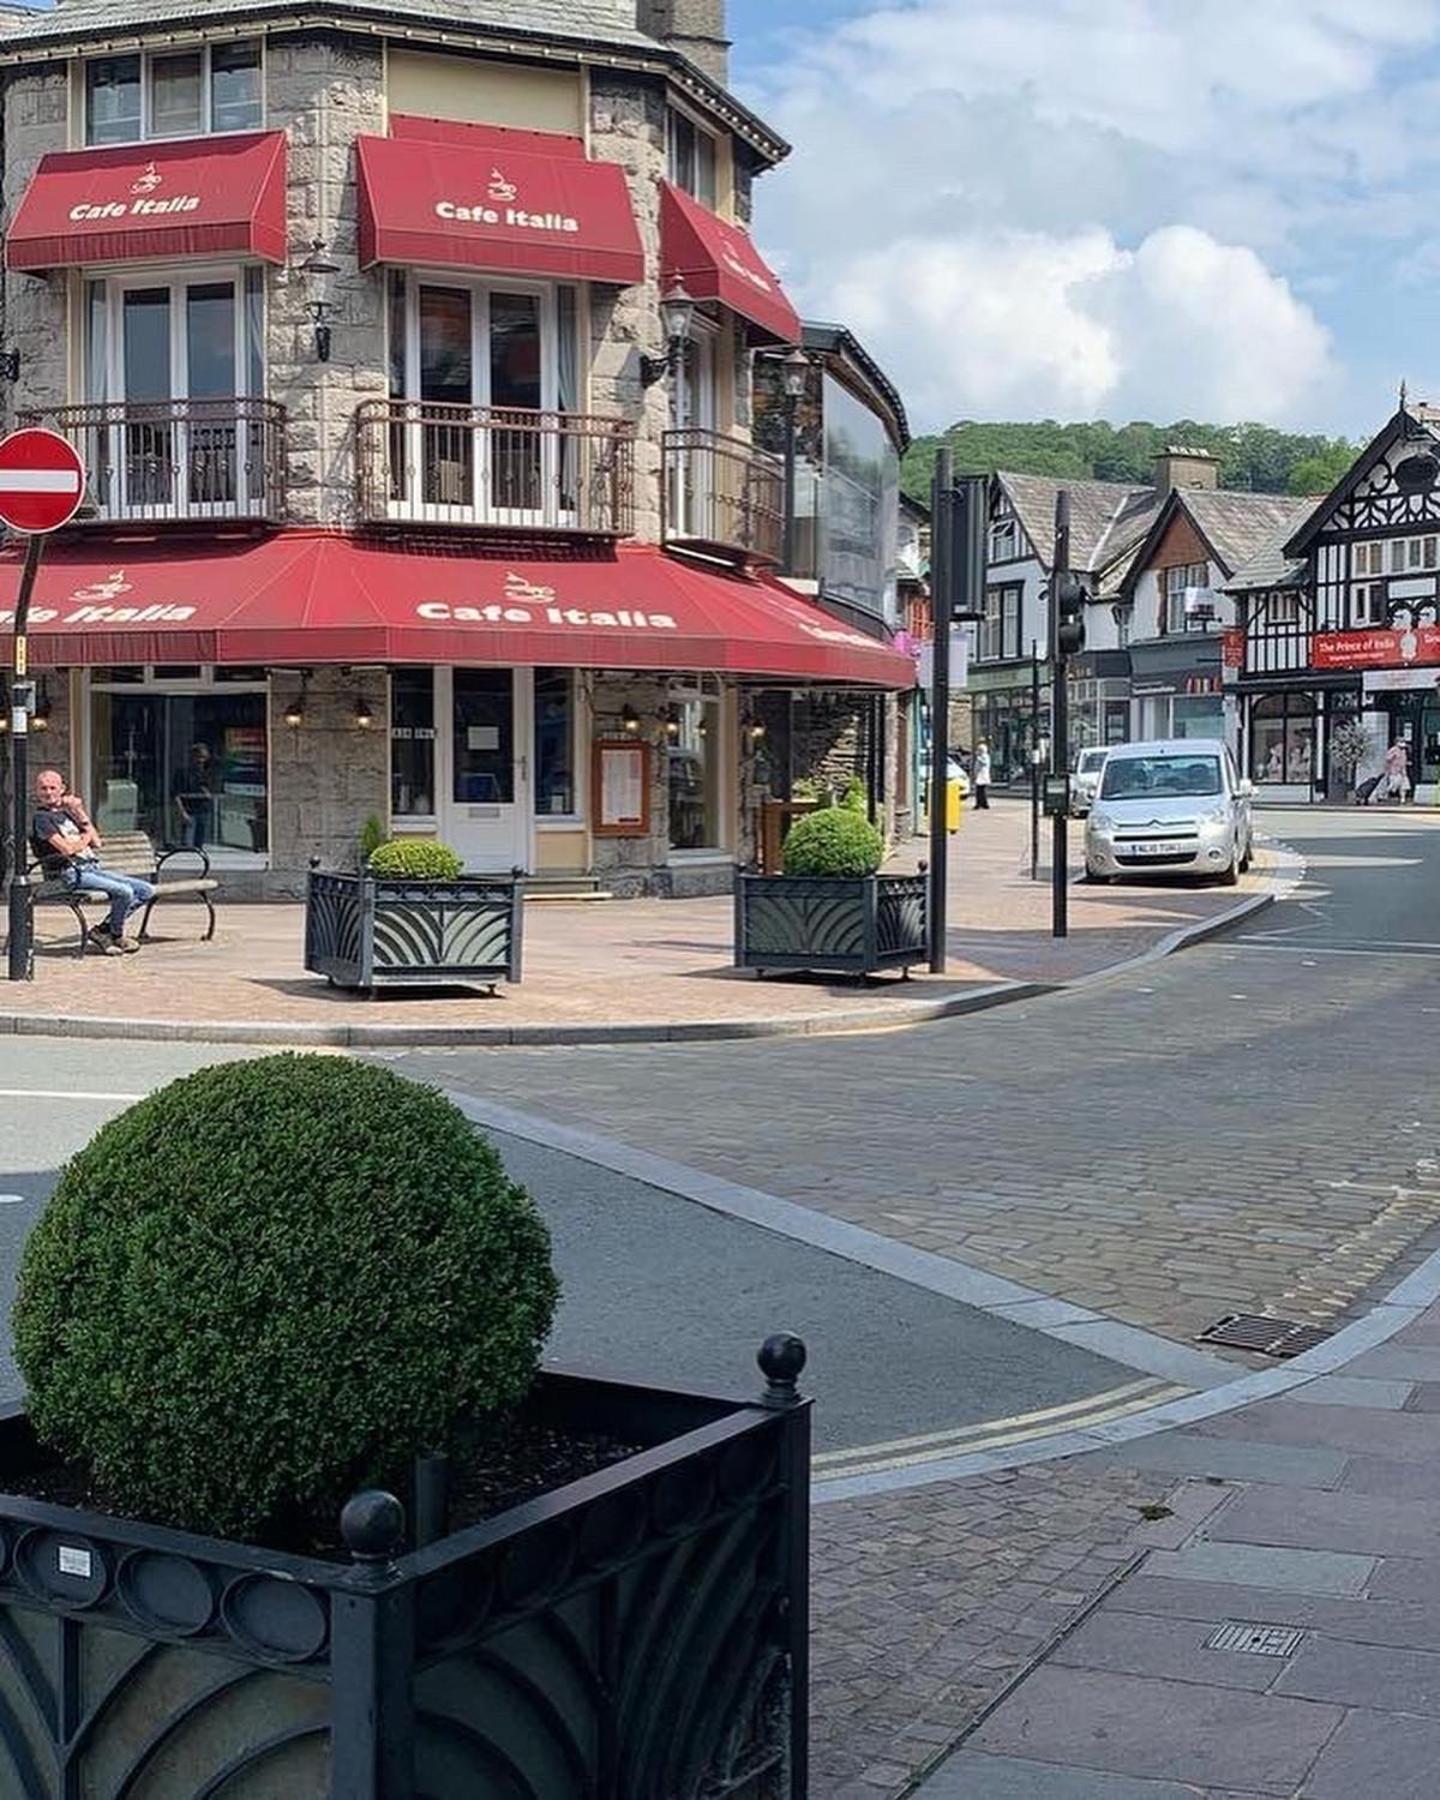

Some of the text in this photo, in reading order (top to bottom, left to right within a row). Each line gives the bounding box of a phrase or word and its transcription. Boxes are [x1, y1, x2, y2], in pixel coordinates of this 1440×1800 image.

[69, 196, 200, 220] Cafe Italia
[435, 201, 579, 232] Cafe Italia
[62, 604, 197, 623] Italia
[416, 602, 678, 629] Cafe Italia
[1319, 638, 1395, 652] The Prince of India
